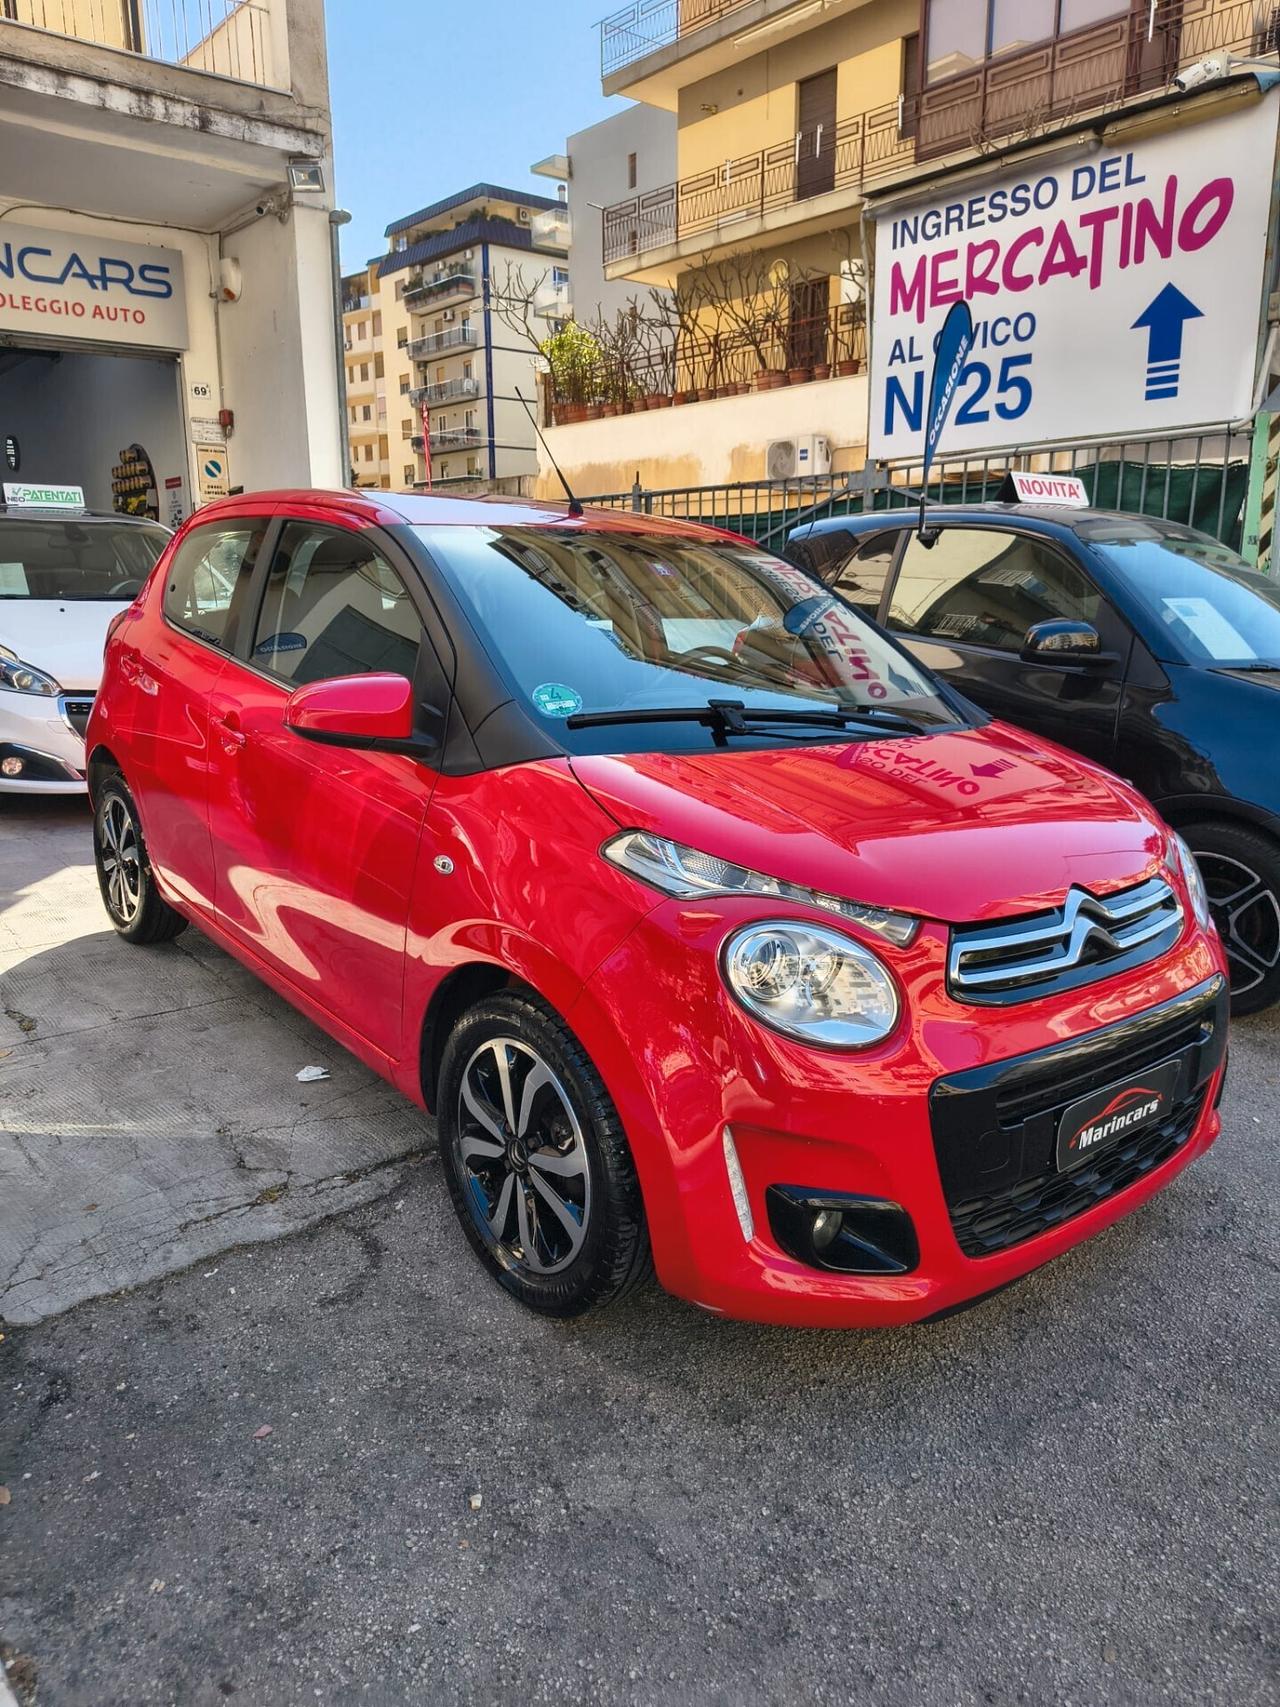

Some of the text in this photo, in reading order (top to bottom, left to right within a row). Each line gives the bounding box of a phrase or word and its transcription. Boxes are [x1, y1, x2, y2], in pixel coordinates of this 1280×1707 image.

[892, 153, 1146, 250] INGRESSO DEL
[890, 175, 1234, 324] MERCATINO
[92, 304, 146, 324] AUTO
[888, 336, 923, 367] AL
[193, 386, 208, 396] 69
[929, 334, 969, 446] OCCASIONE
[955, 353, 1032, 426] 25
[22, 488, 83, 503] PATENTATI
[1018, 479, 1080, 499] NOVITA'
[1078, 1099, 1160, 1151] Marincars
